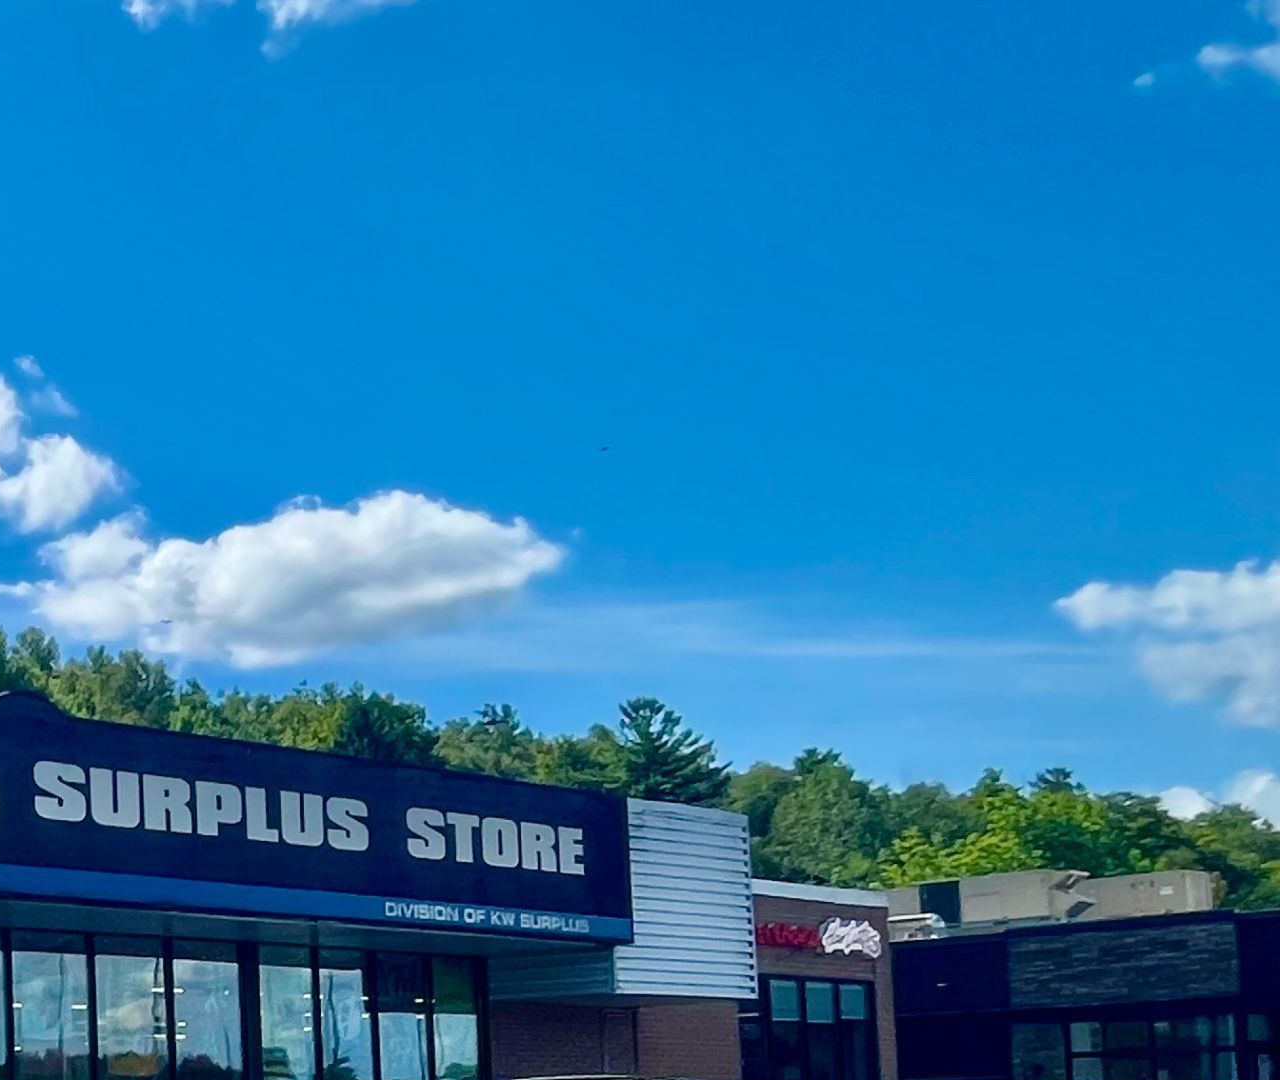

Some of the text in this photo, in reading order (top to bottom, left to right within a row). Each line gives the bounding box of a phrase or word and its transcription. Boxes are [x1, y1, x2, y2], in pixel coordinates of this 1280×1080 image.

[33, 760, 586, 876] SURPLUS STORE
[385, 902, 590, 933] DIVISION OF KW SURPLUS
